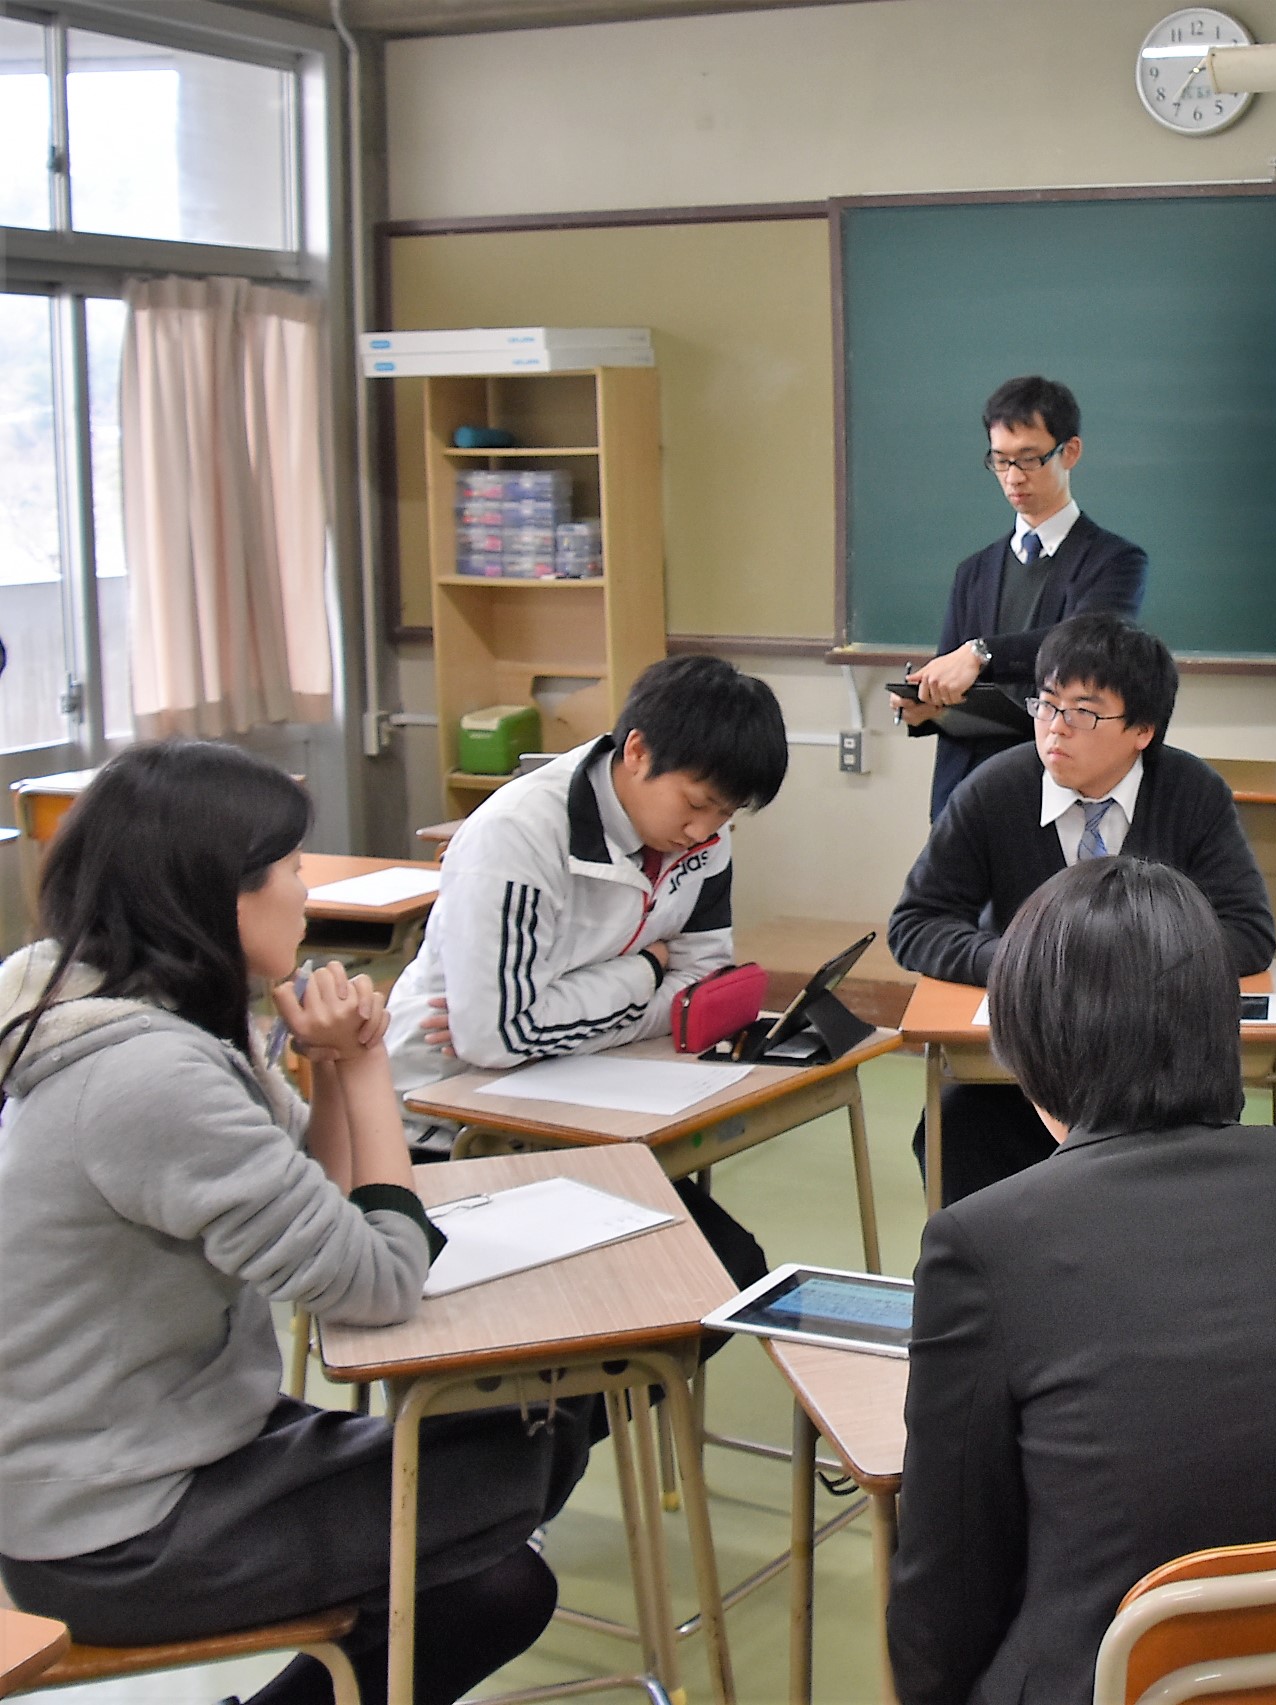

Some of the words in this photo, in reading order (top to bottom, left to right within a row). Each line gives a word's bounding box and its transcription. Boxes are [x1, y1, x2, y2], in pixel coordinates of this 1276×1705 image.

[1171, 28, 1182, 42] 11
[1191, 20, 1203, 36] 12
[1215, 25, 1220, 39] 1
[1150, 66, 1159, 79] 9
[1156, 87, 1165, 101] 8
[1172, 102, 1181, 117] 7
[1193, 106, 1202, 121] 6
[1215, 100, 1223, 114] 5
